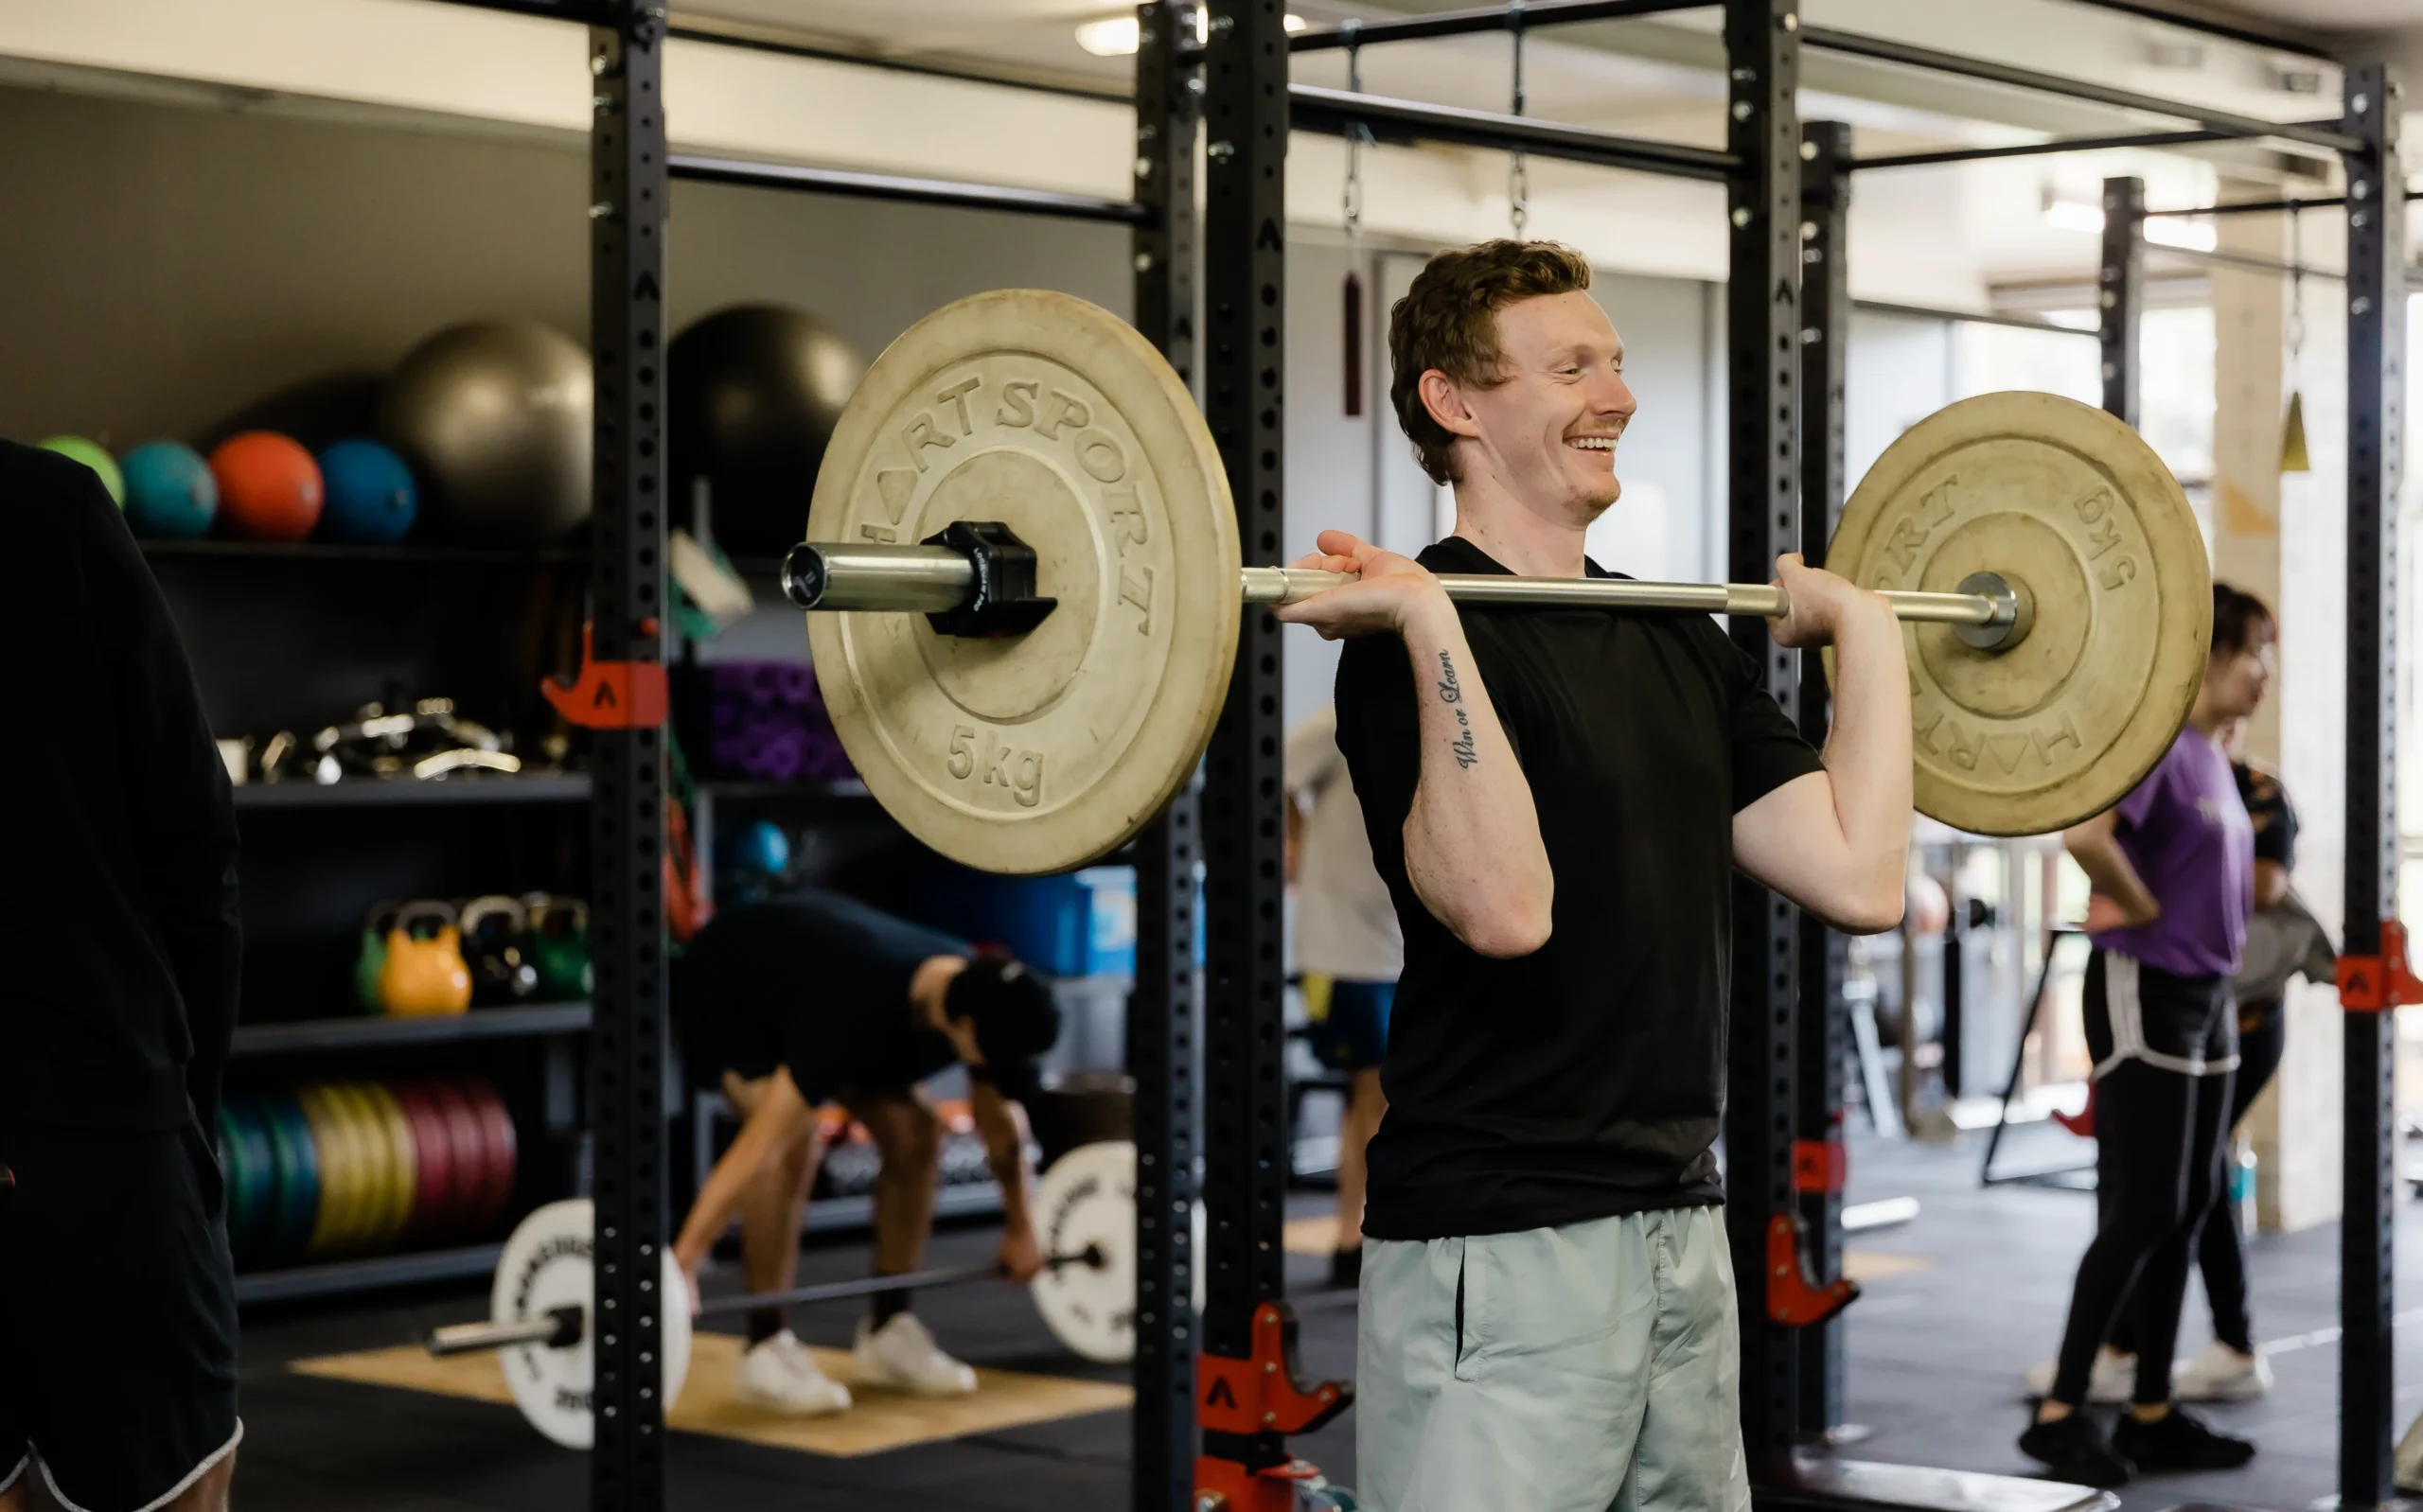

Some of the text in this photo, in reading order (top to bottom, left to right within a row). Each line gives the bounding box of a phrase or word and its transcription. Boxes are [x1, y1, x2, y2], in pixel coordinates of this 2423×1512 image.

[995, 380, 1155, 637] SPORT
[2073, 485, 2136, 591] 5kg
[1438, 649, 1477, 769] Win or Learn
[947, 725, 1044, 807] 5kg
